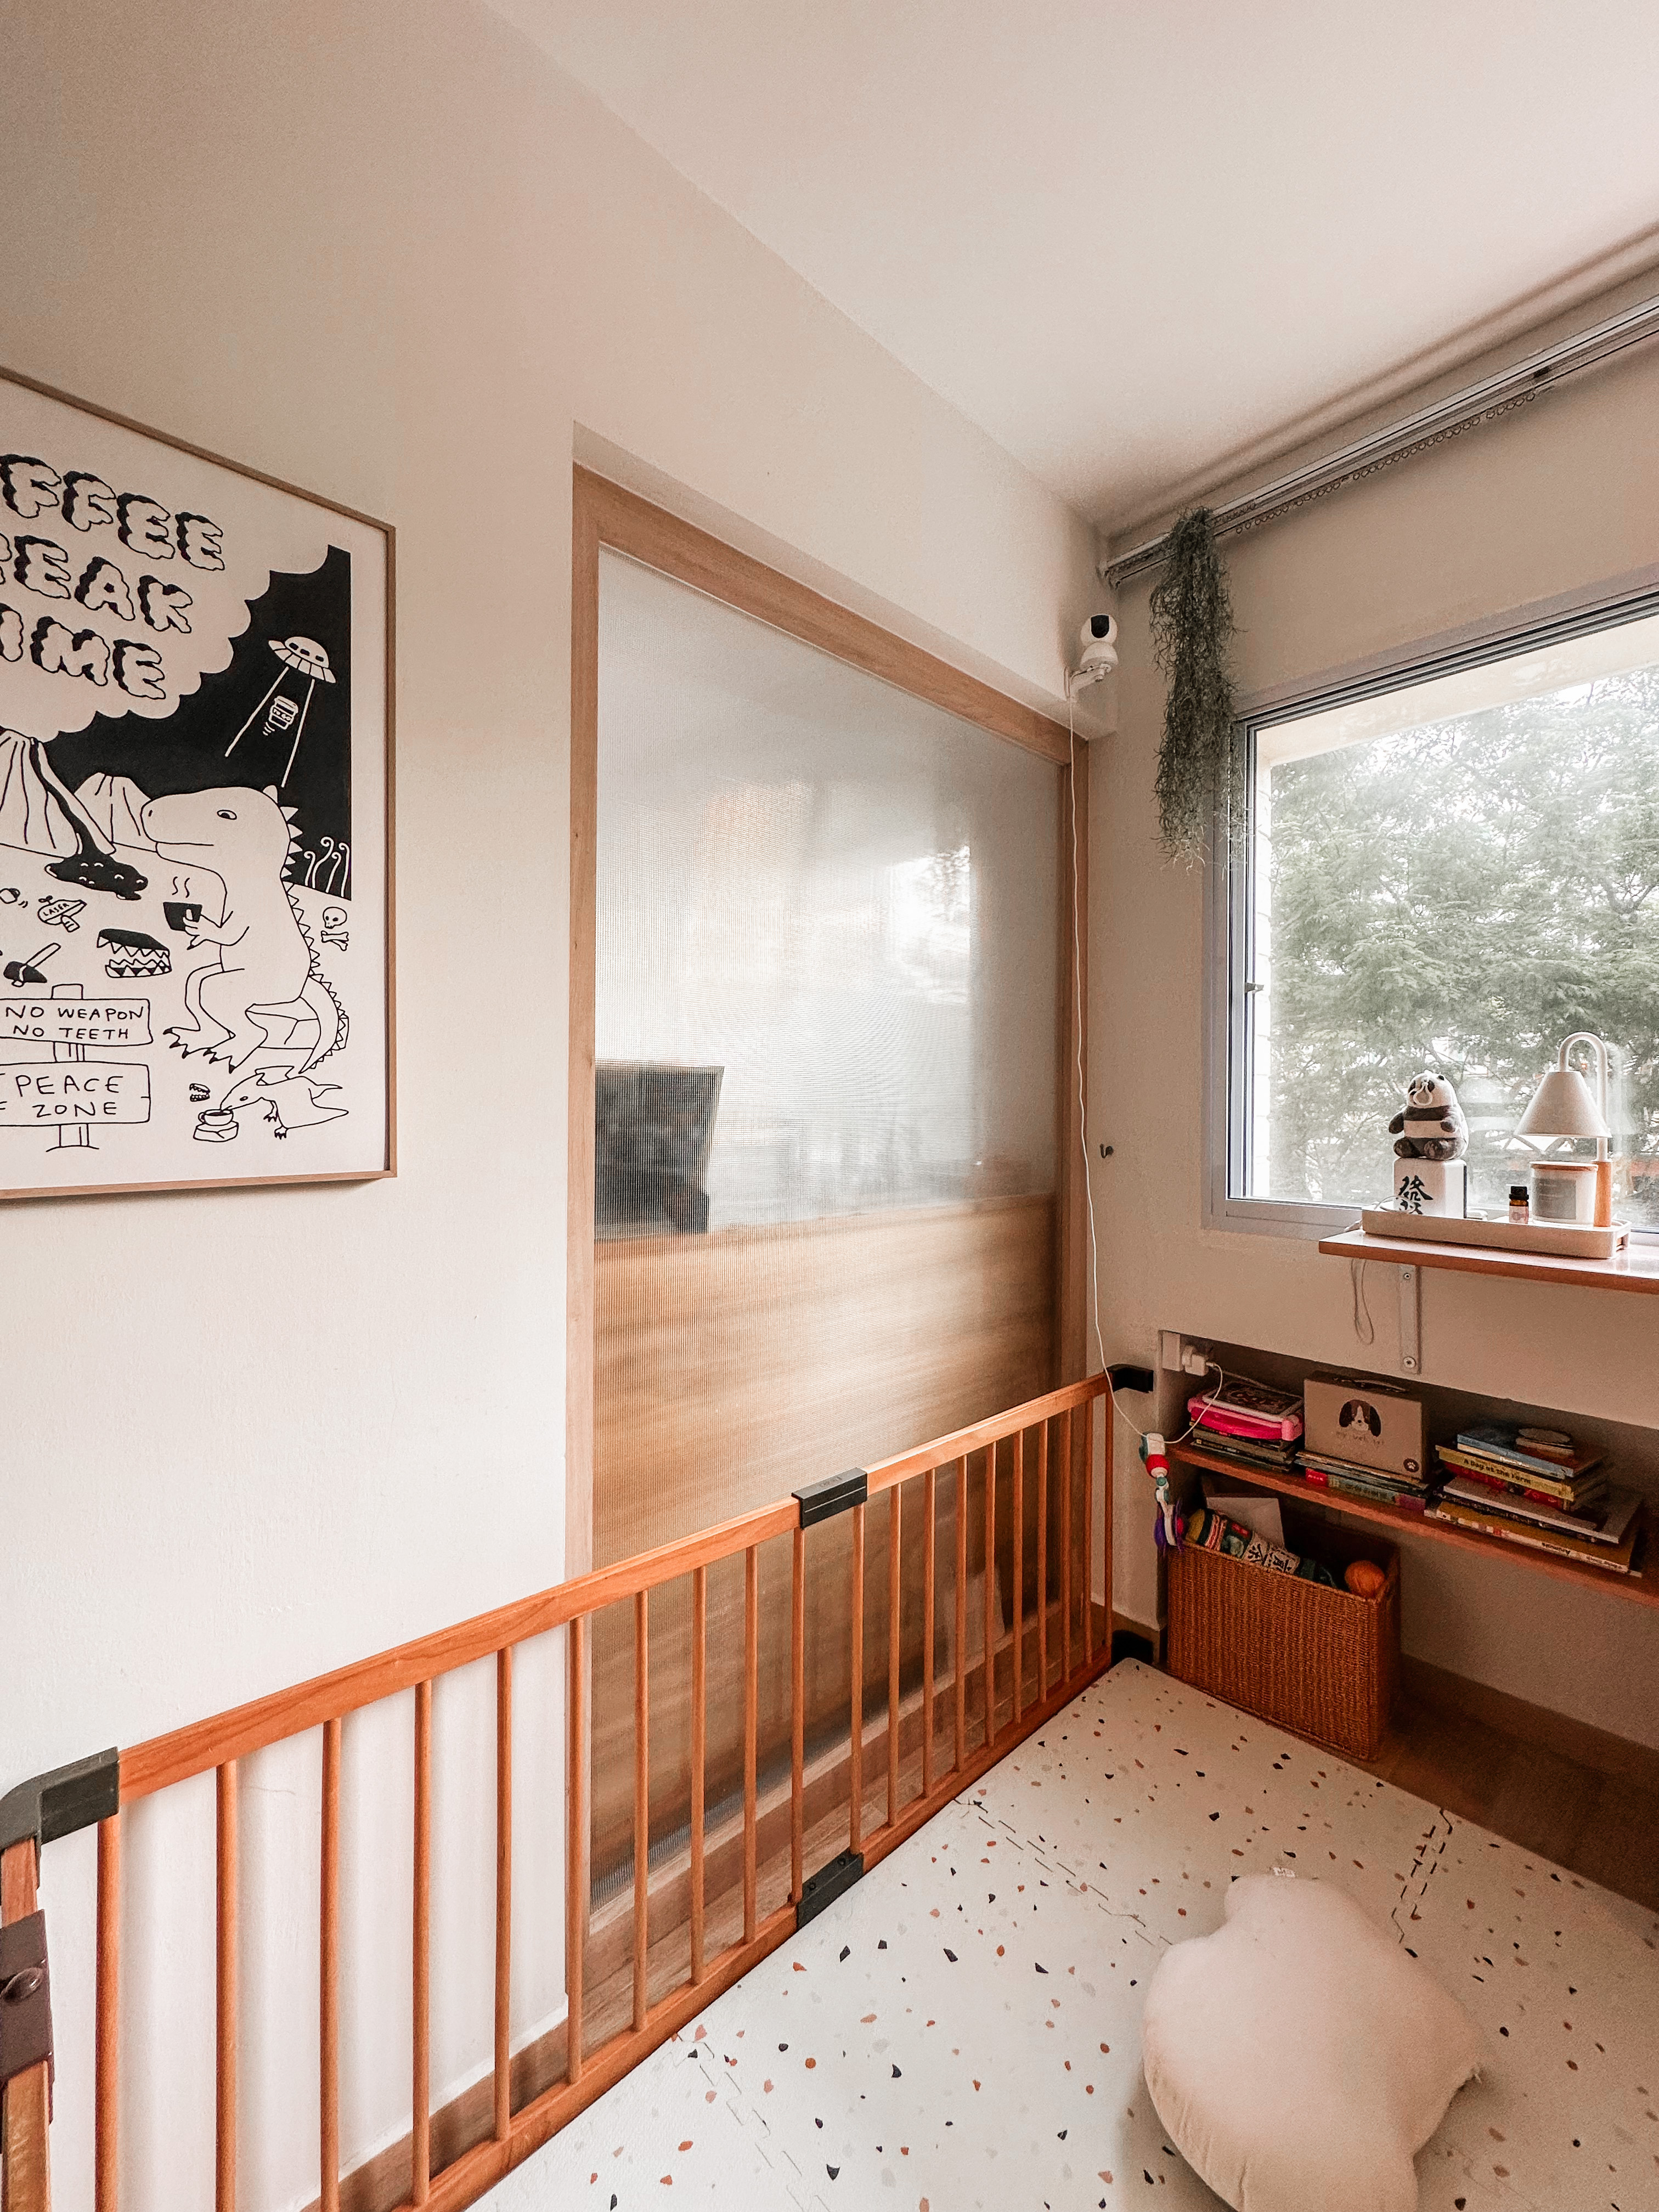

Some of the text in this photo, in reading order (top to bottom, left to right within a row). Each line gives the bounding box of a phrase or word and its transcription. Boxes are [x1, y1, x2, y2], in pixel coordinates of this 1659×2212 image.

[0, 532, 193, 634] EAK
[43, 903, 70, 916] LASER
[5, 1005, 144, 1022] NO WEAPON
[13, 1025, 128, 1040] NO TEETH
[15, 1075, 123, 1097] PEACE
[32, 1102, 117, 1118] ZONE
[1470, 1460, 1485, 1471] Day
[1496, 1469, 1511, 1478] the
[1511, 1473, 1532, 1485] Farm
